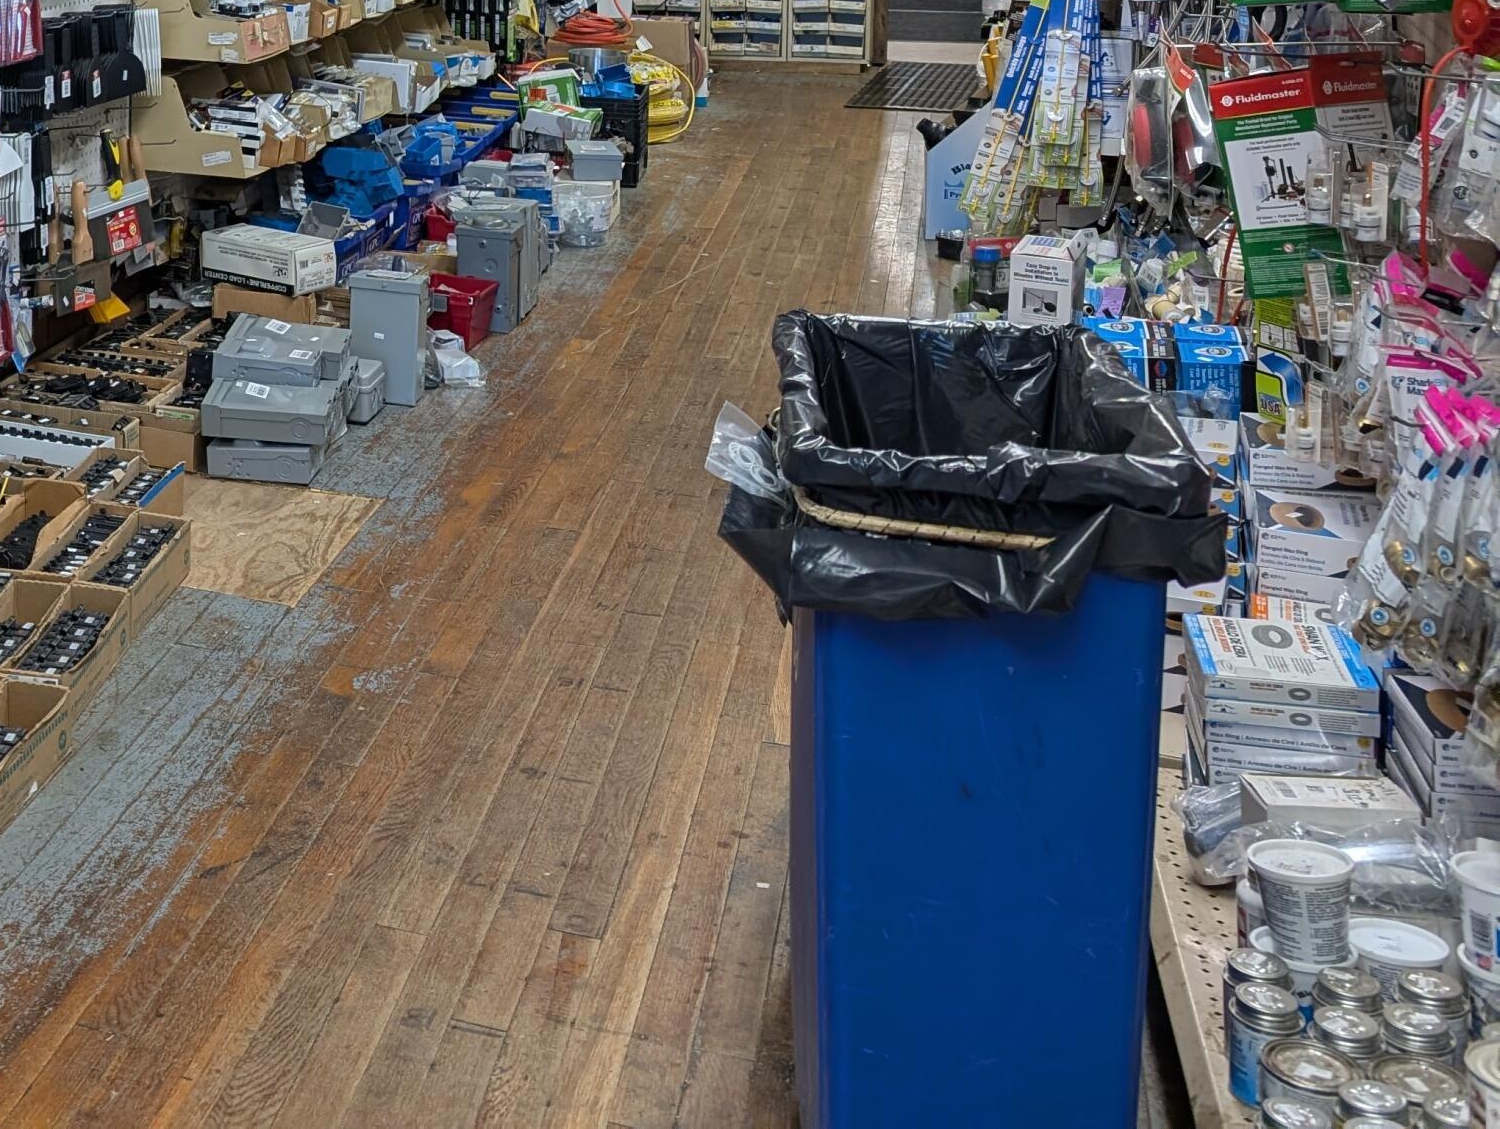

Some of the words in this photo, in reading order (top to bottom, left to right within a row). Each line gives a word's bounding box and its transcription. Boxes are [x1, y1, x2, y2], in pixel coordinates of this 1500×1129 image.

[1334, 81, 1377, 93] Fluidmaster
[1235, 89, 1301, 104] Fluidmaster
[204, 270, 228, 281] CENTER
[229, 275, 246, 284] LOAD
[1260, 399, 1281, 415] USA
